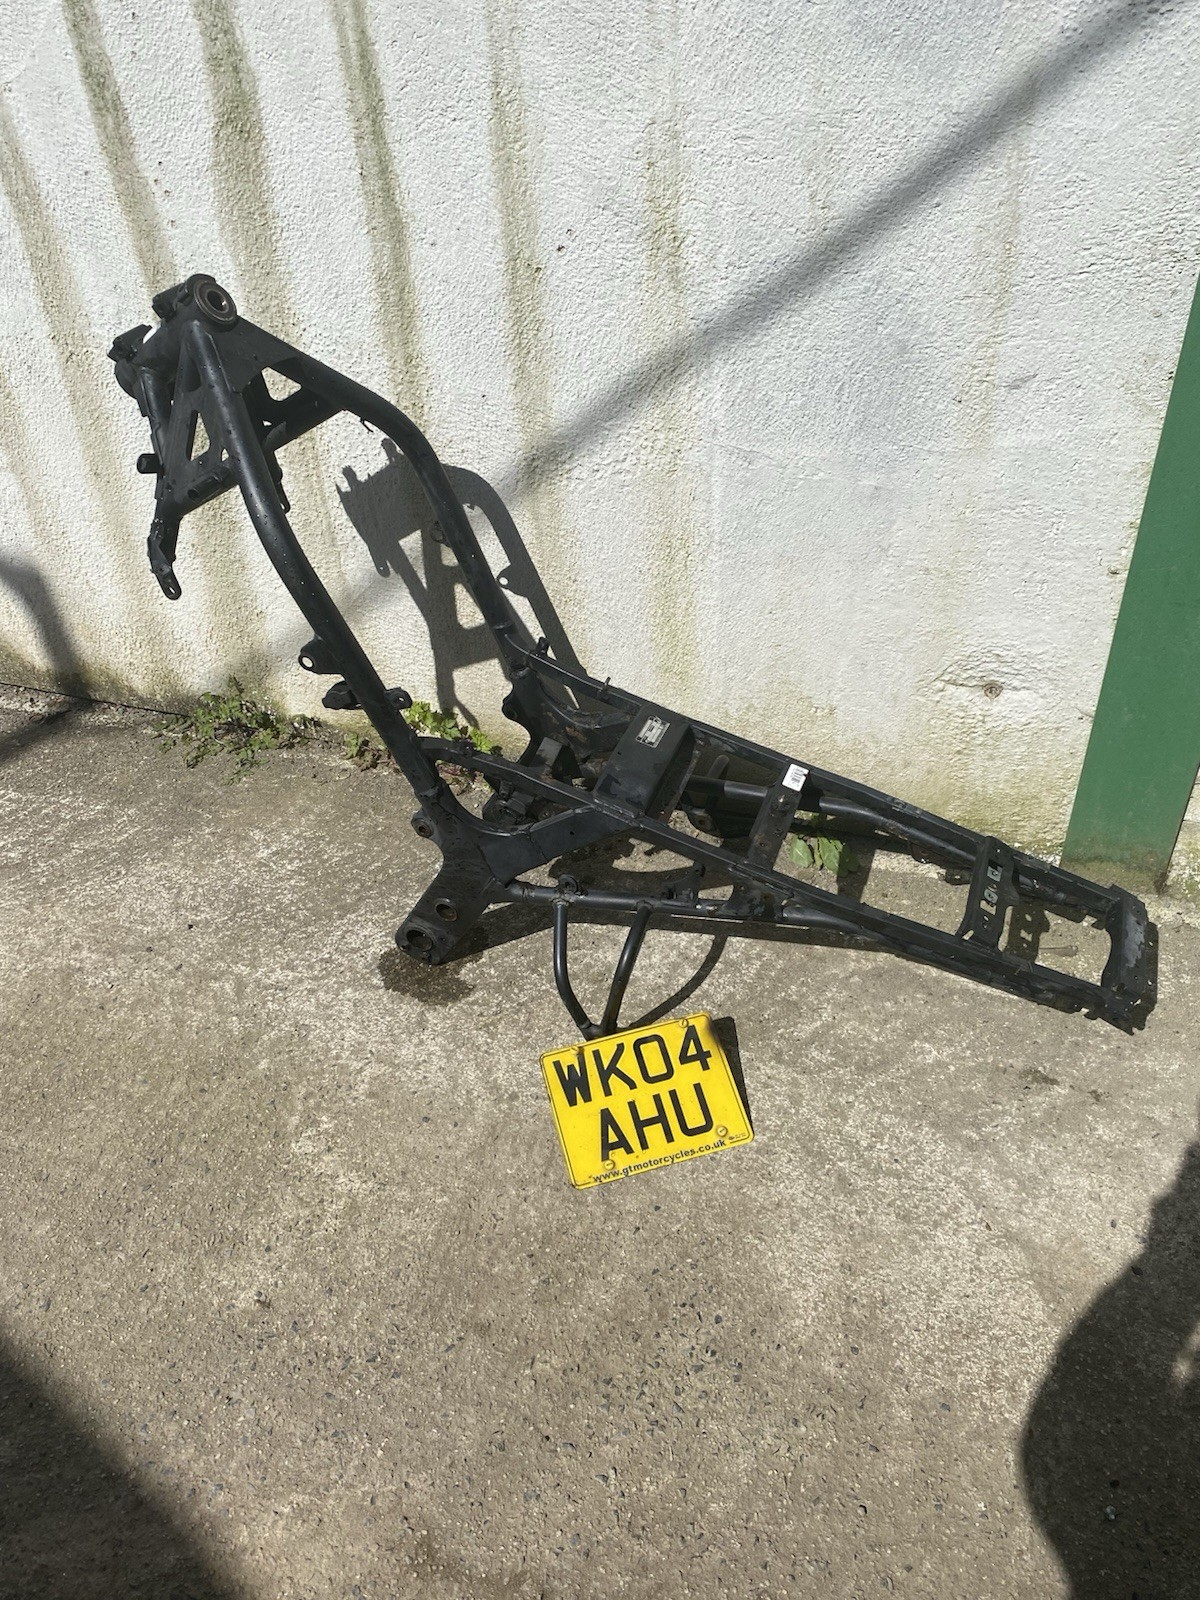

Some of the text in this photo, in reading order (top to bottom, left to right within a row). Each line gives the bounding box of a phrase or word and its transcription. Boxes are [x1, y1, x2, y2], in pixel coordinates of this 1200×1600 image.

[552, 1024, 712, 1107] WK04
[592, 1139, 726, 1182] www.gtmotorcycles.co.uk
[601, 1082, 714, 1162] AHU
